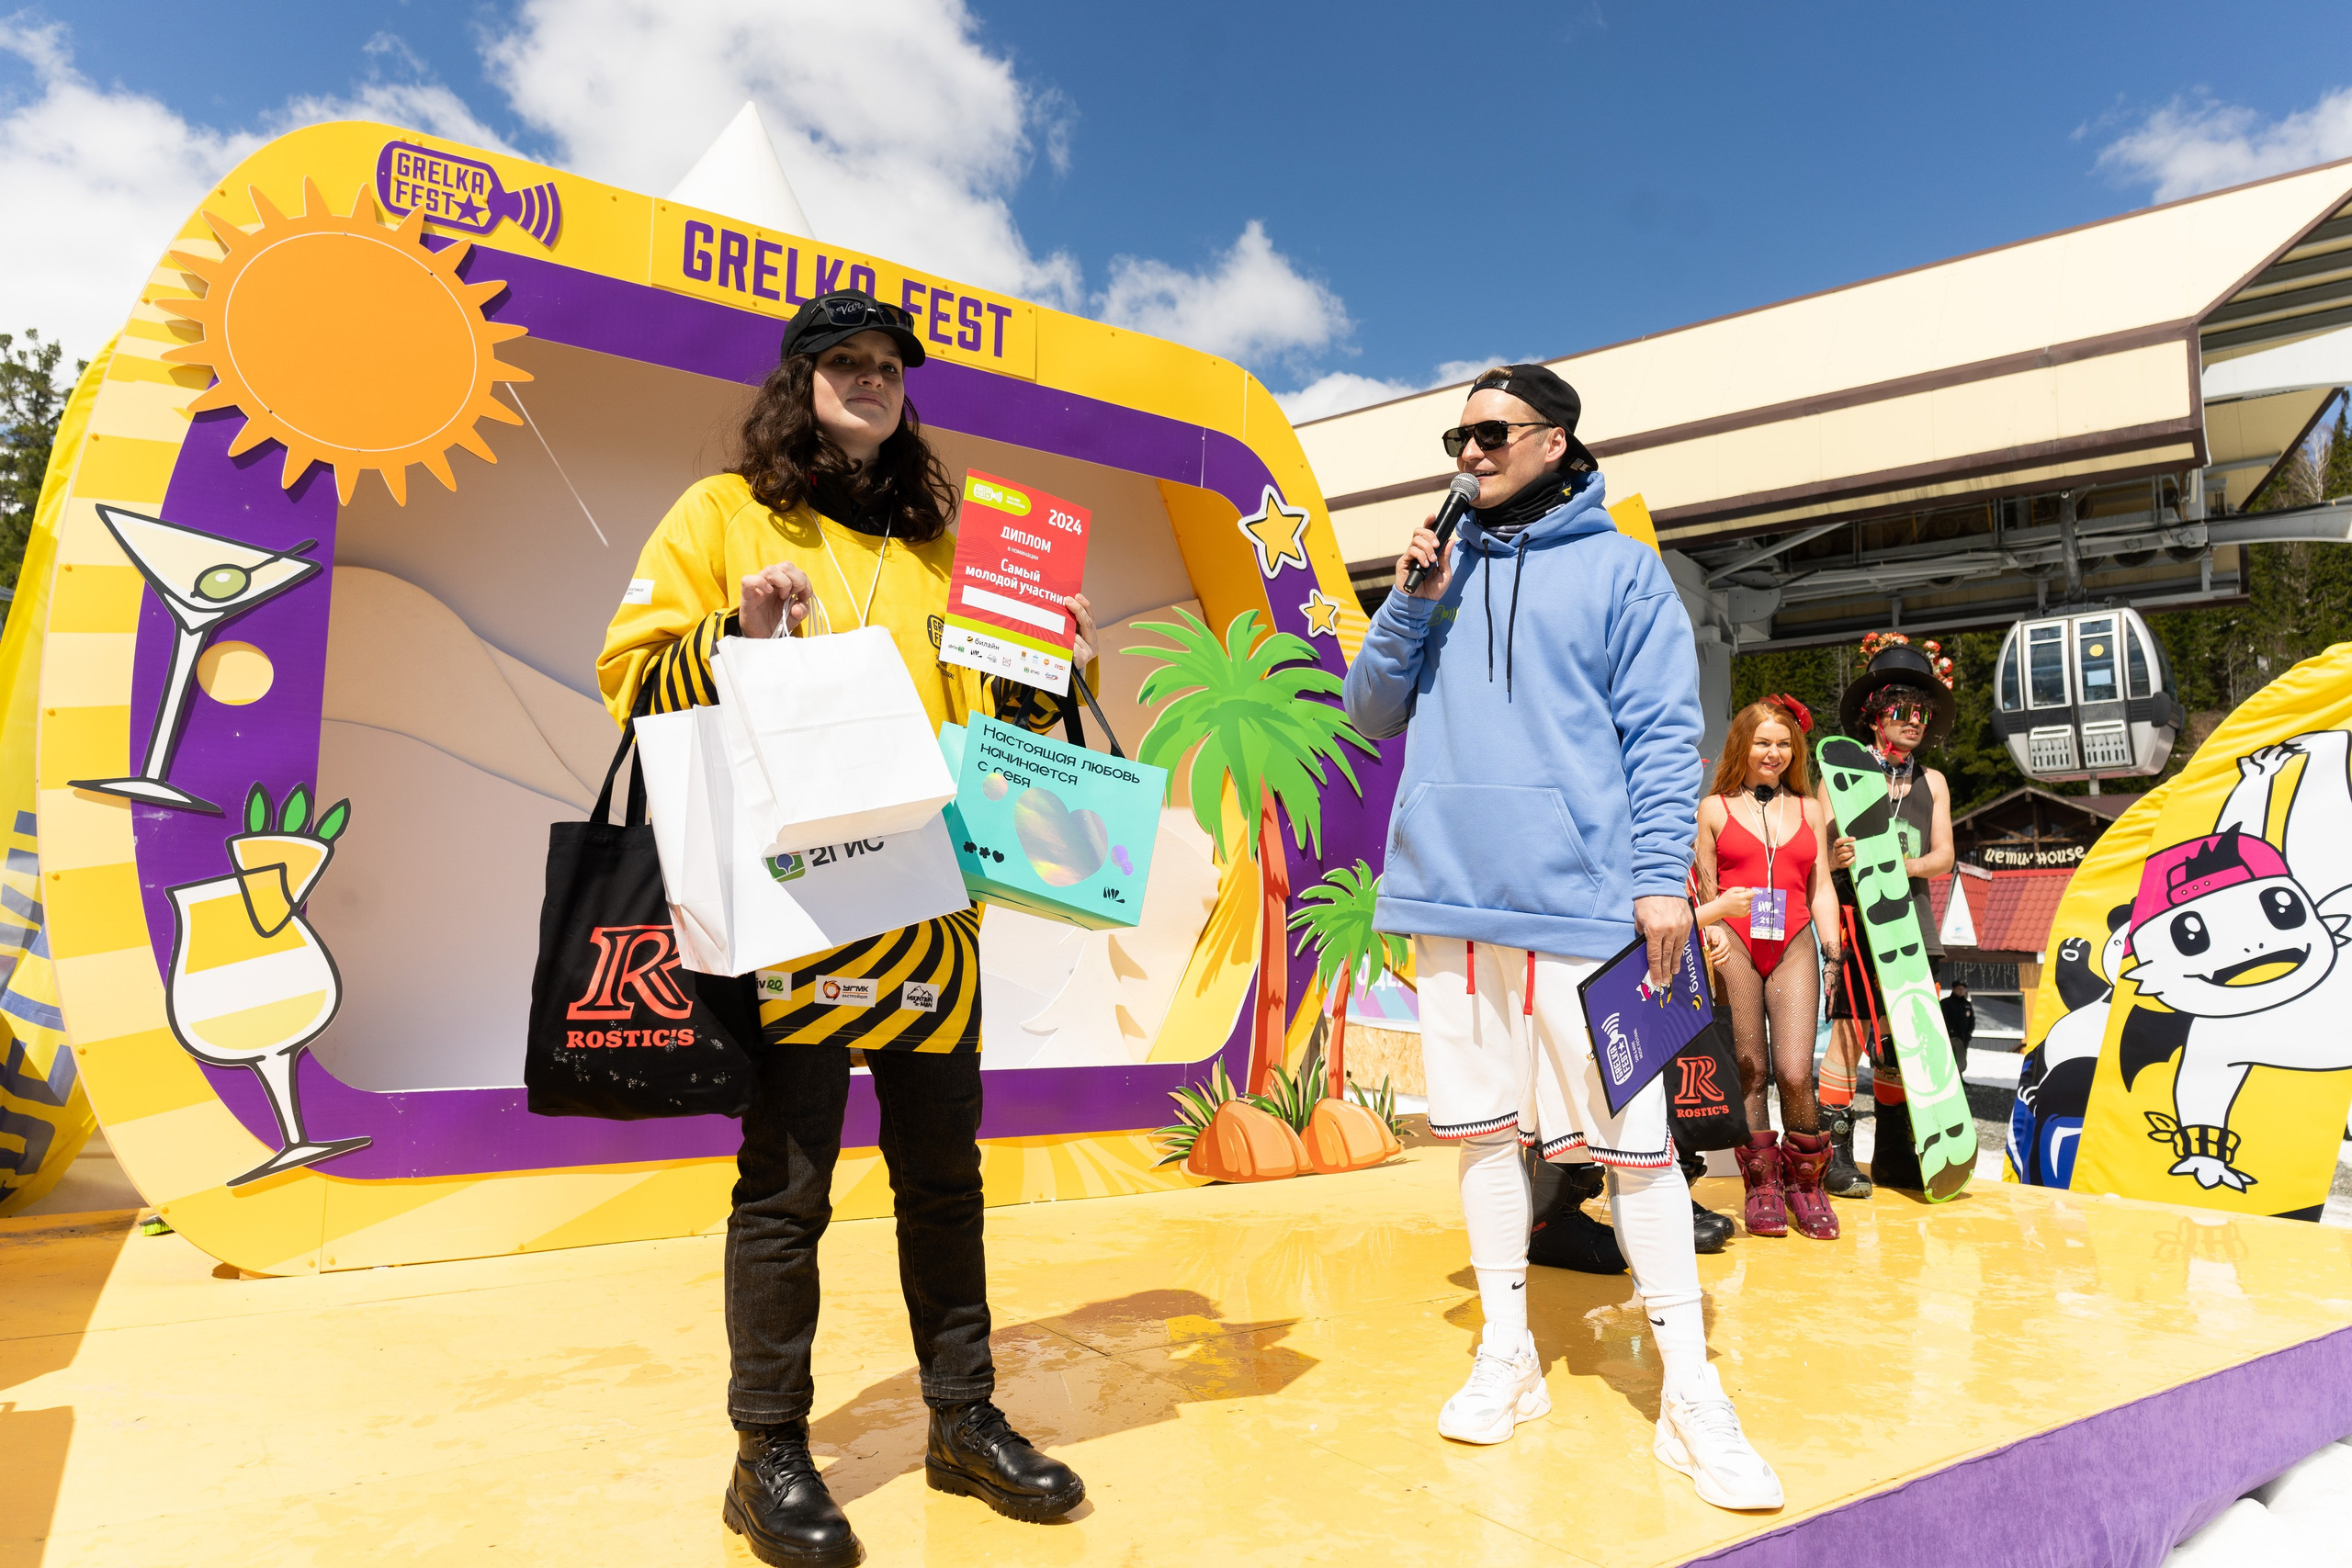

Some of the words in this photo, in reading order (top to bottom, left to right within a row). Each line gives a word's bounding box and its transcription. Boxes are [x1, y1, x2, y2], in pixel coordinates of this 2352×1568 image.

[397, 152, 485, 196] GRELKA
[396, 180, 456, 216] FEST
[900, 277, 1013, 358] FEST
[1048, 509, 1082, 536] 2024
[1001, 525, 1052, 553] ДИПЛОМ
[1012, 547, 1039, 561] номинации
[1001, 558, 1041, 582] Самый
[966, 565, 1018, 590] молодой
[1018, 581, 1066, 606] участни
[975, 637, 1000, 651] билайн
[983, 724, 1077, 766] Настоящая
[978, 761, 989, 772] с
[980, 743, 1078, 785] начинается
[566, 1028, 695, 1049] ROSTIC'S
[1610, 1044, 1624, 1080] GRELKA
[1619, 1050, 1631, 1074] FEST
[1674, 1055, 1724, 1105] R
[1677, 1104, 1729, 1119] ROSTIC'S
